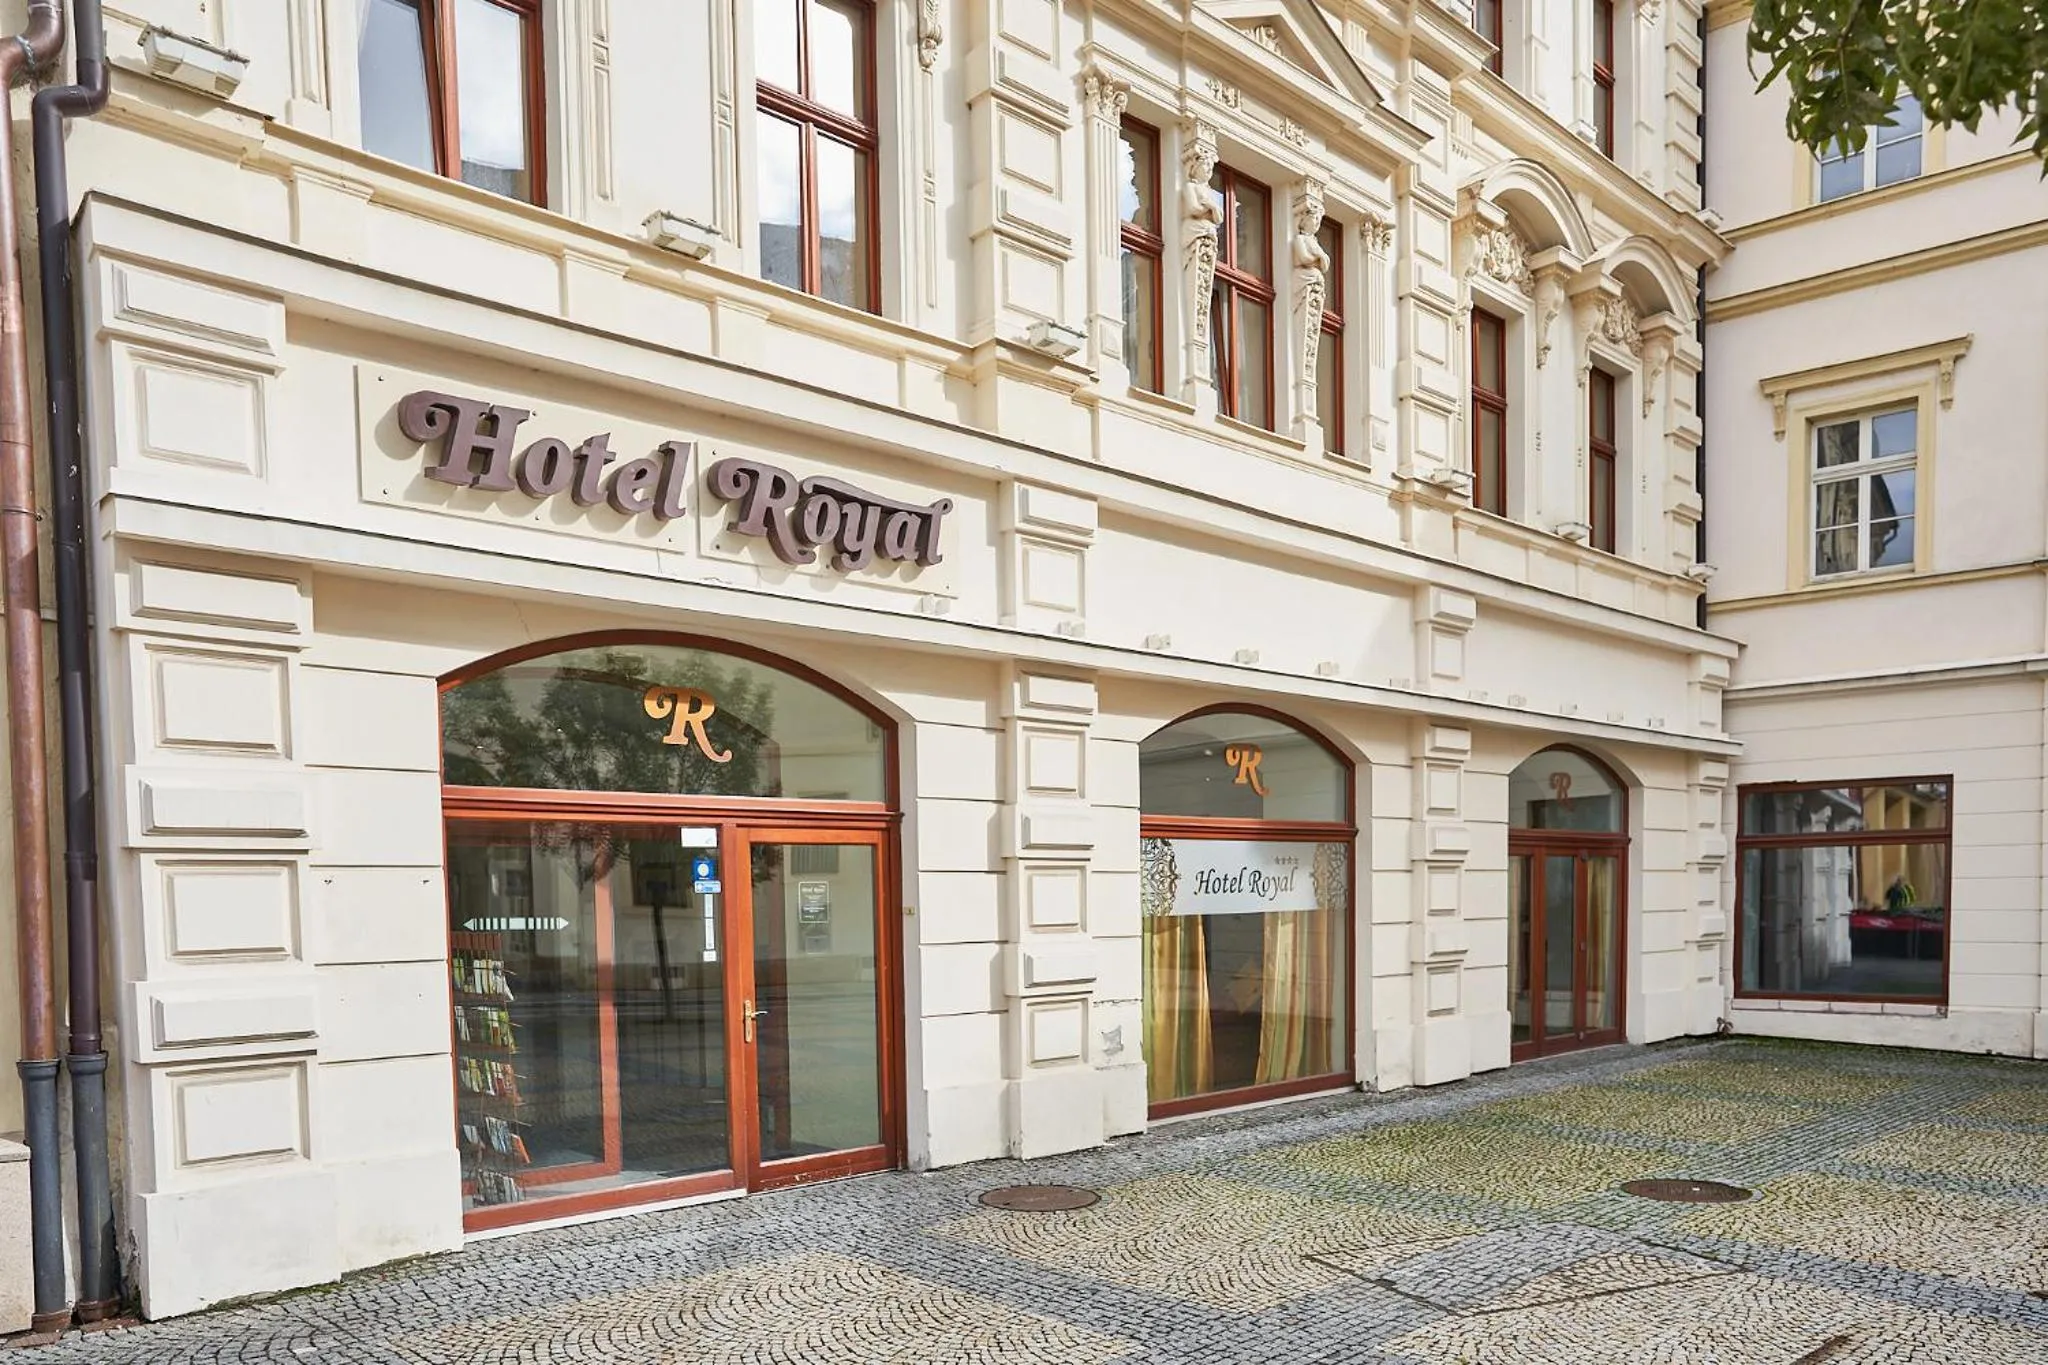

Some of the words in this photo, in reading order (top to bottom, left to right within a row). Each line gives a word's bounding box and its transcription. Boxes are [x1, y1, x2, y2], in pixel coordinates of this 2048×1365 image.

[398, 390, 692, 521] Hotel
[707, 457, 953, 572] Royal
[644, 686, 732, 762] R
[1225, 743, 1271, 796] R
[1194, 867, 1246, 896] Hotel
[1249, 867, 1297, 901] Royal
